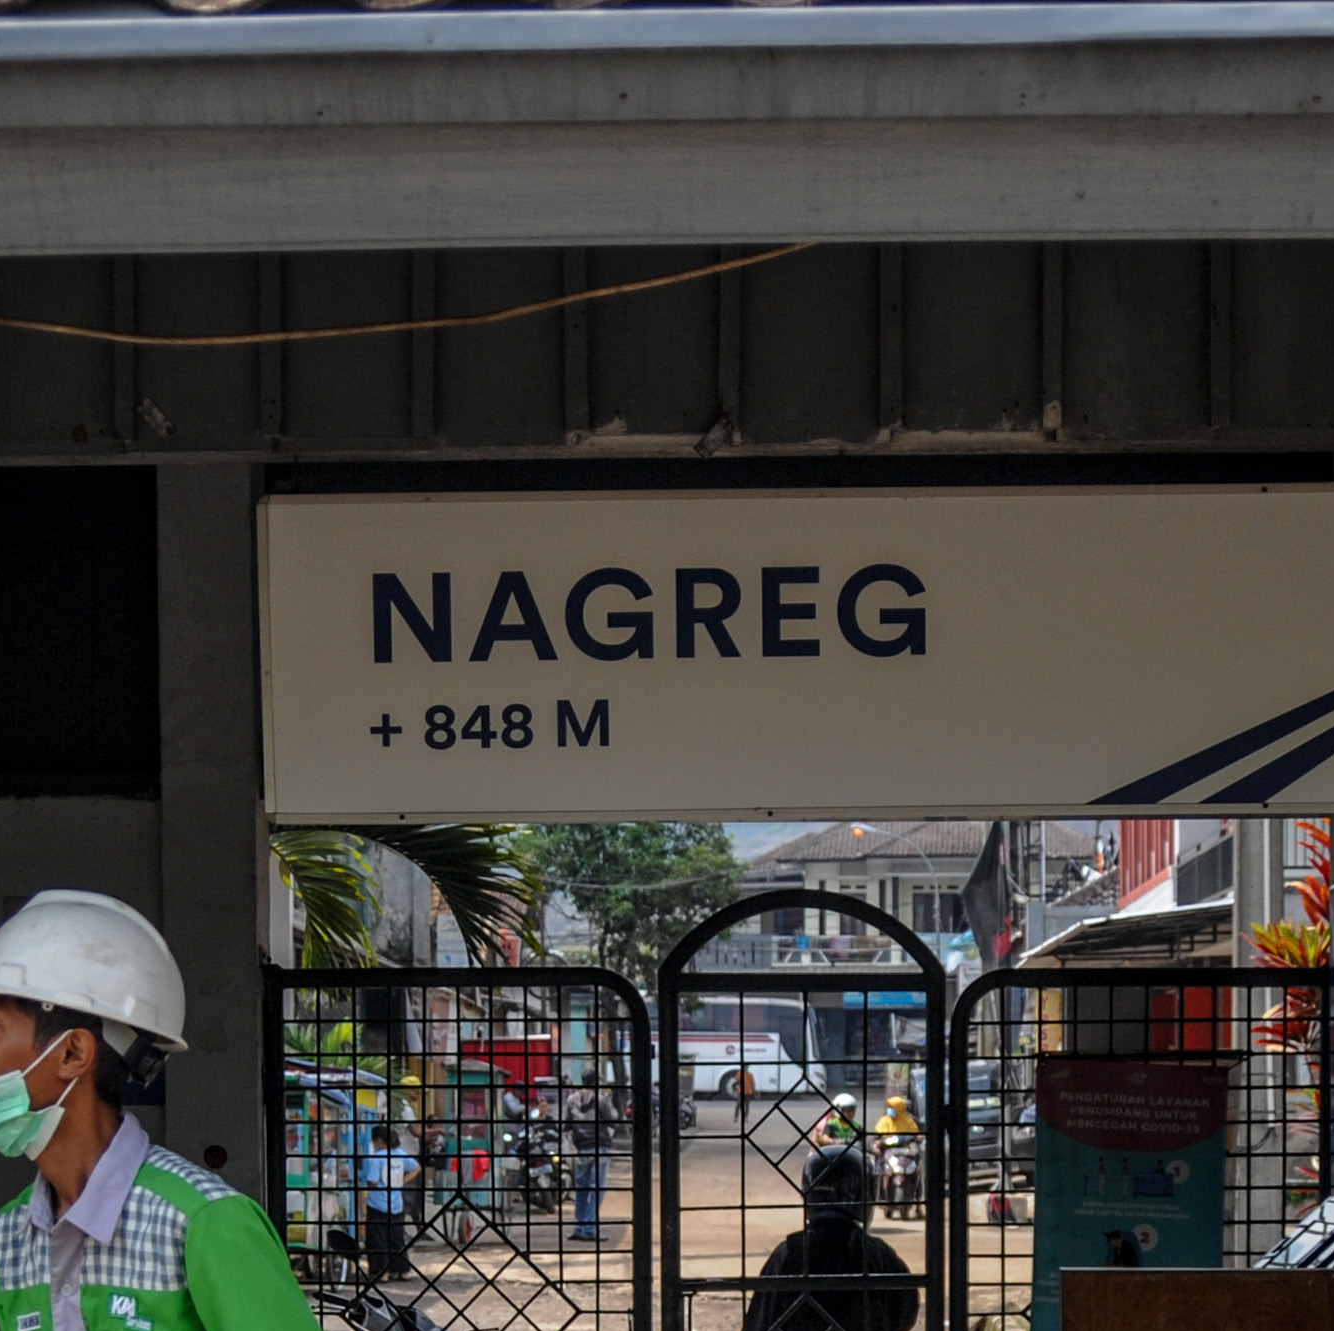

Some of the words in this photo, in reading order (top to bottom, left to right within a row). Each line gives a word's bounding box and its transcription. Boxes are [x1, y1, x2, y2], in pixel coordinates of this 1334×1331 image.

[373, 563, 929, 664] NAGREG
[424, 703, 533, 750] 848
[556, 698, 610, 748] M
[1059, 1091, 1145, 1105] PENGATURAN
[1149, 1097, 1211, 1108] LAYANAN
[1070, 1105, 1151, 1118] PENUMPANG
[1154, 1110, 1198, 1120] UNTUK
[1066, 1119, 1138, 1131] MENCEGAH
[1141, 1122, 1201, 1133] COVID-19
[1140, 1231, 1150, 1244] 2
